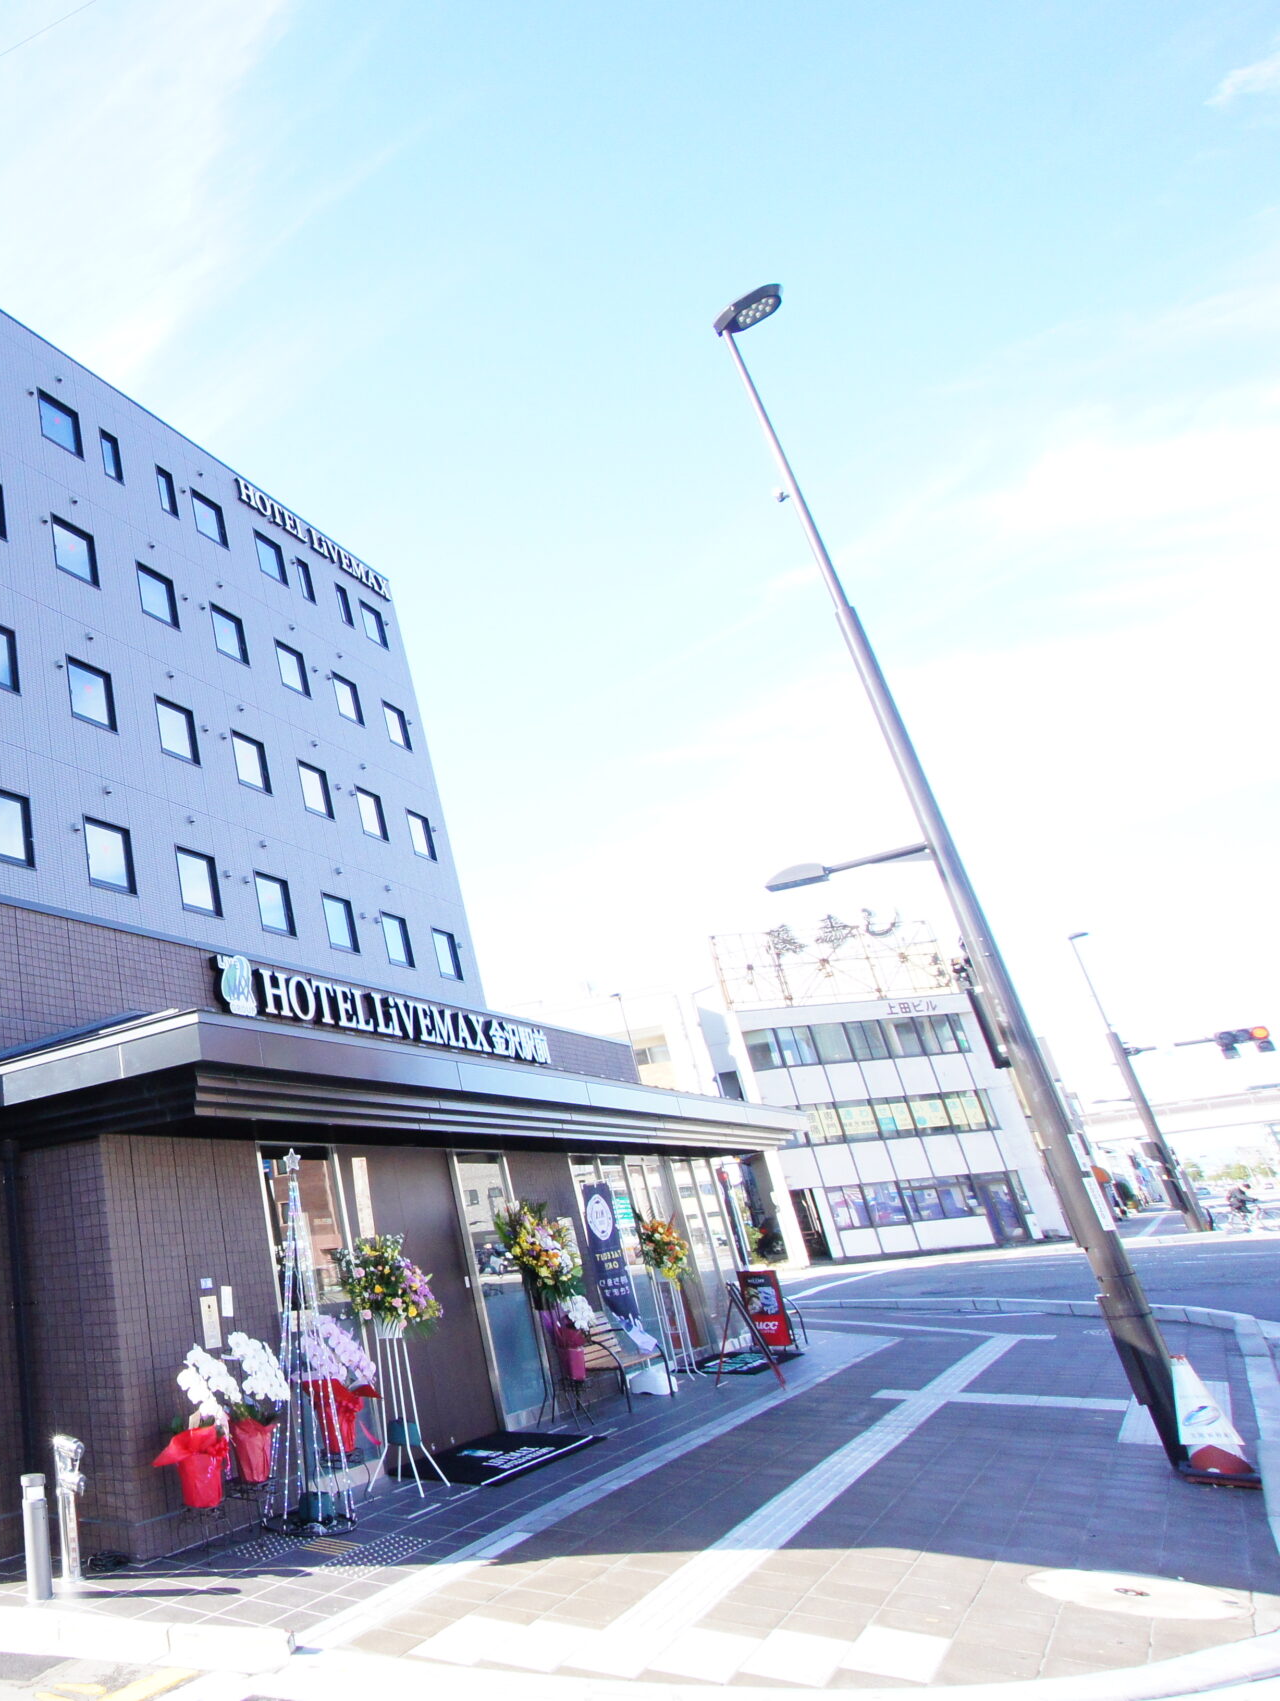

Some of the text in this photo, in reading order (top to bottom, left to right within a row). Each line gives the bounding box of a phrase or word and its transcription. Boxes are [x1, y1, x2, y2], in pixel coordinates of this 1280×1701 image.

[234, 477, 308, 544] HOTEL
[258, 968, 375, 1033] HOTEL
[489, 1019, 552, 1064] 金沢駅前
[886, 1000, 938, 1016] 上田ビル
